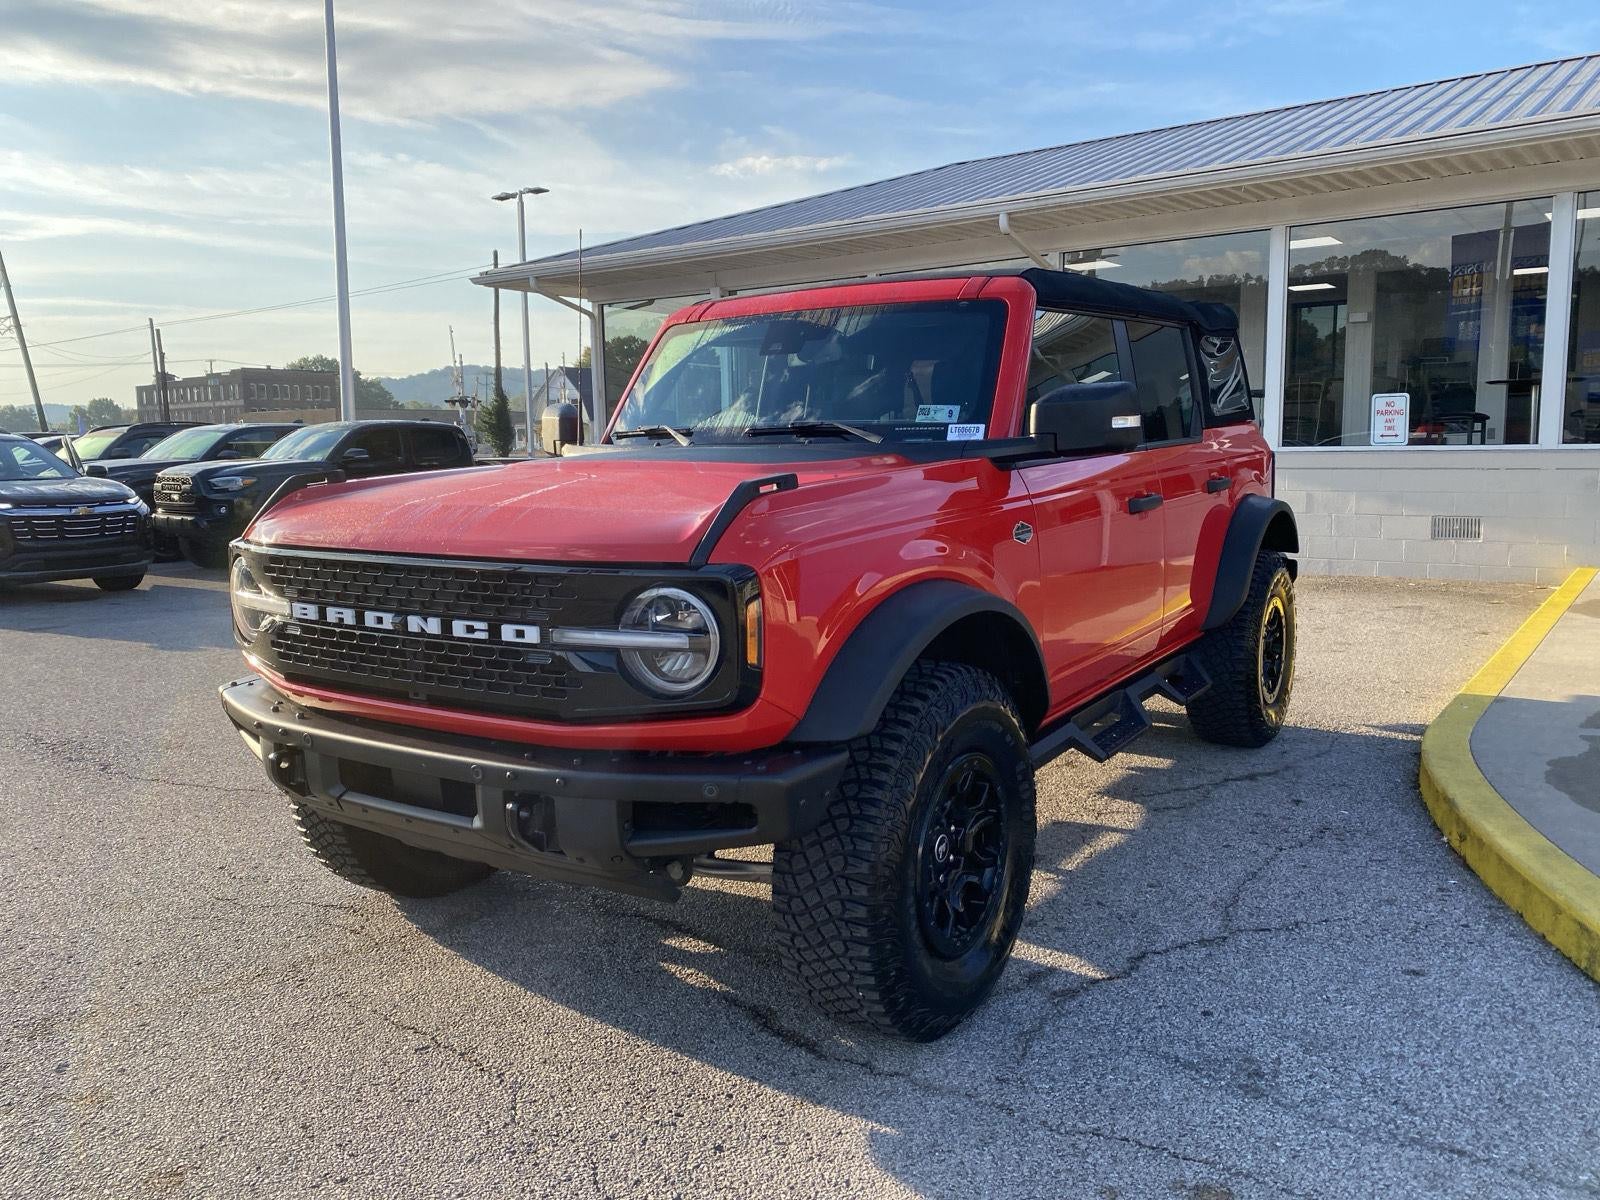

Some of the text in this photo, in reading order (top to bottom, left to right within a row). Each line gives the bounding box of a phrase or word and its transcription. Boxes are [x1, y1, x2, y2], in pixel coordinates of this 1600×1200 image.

[1385, 400, 1395, 408] NO
[947, 409, 953, 418] 9
[291, 602, 540, 644] BRONCO
